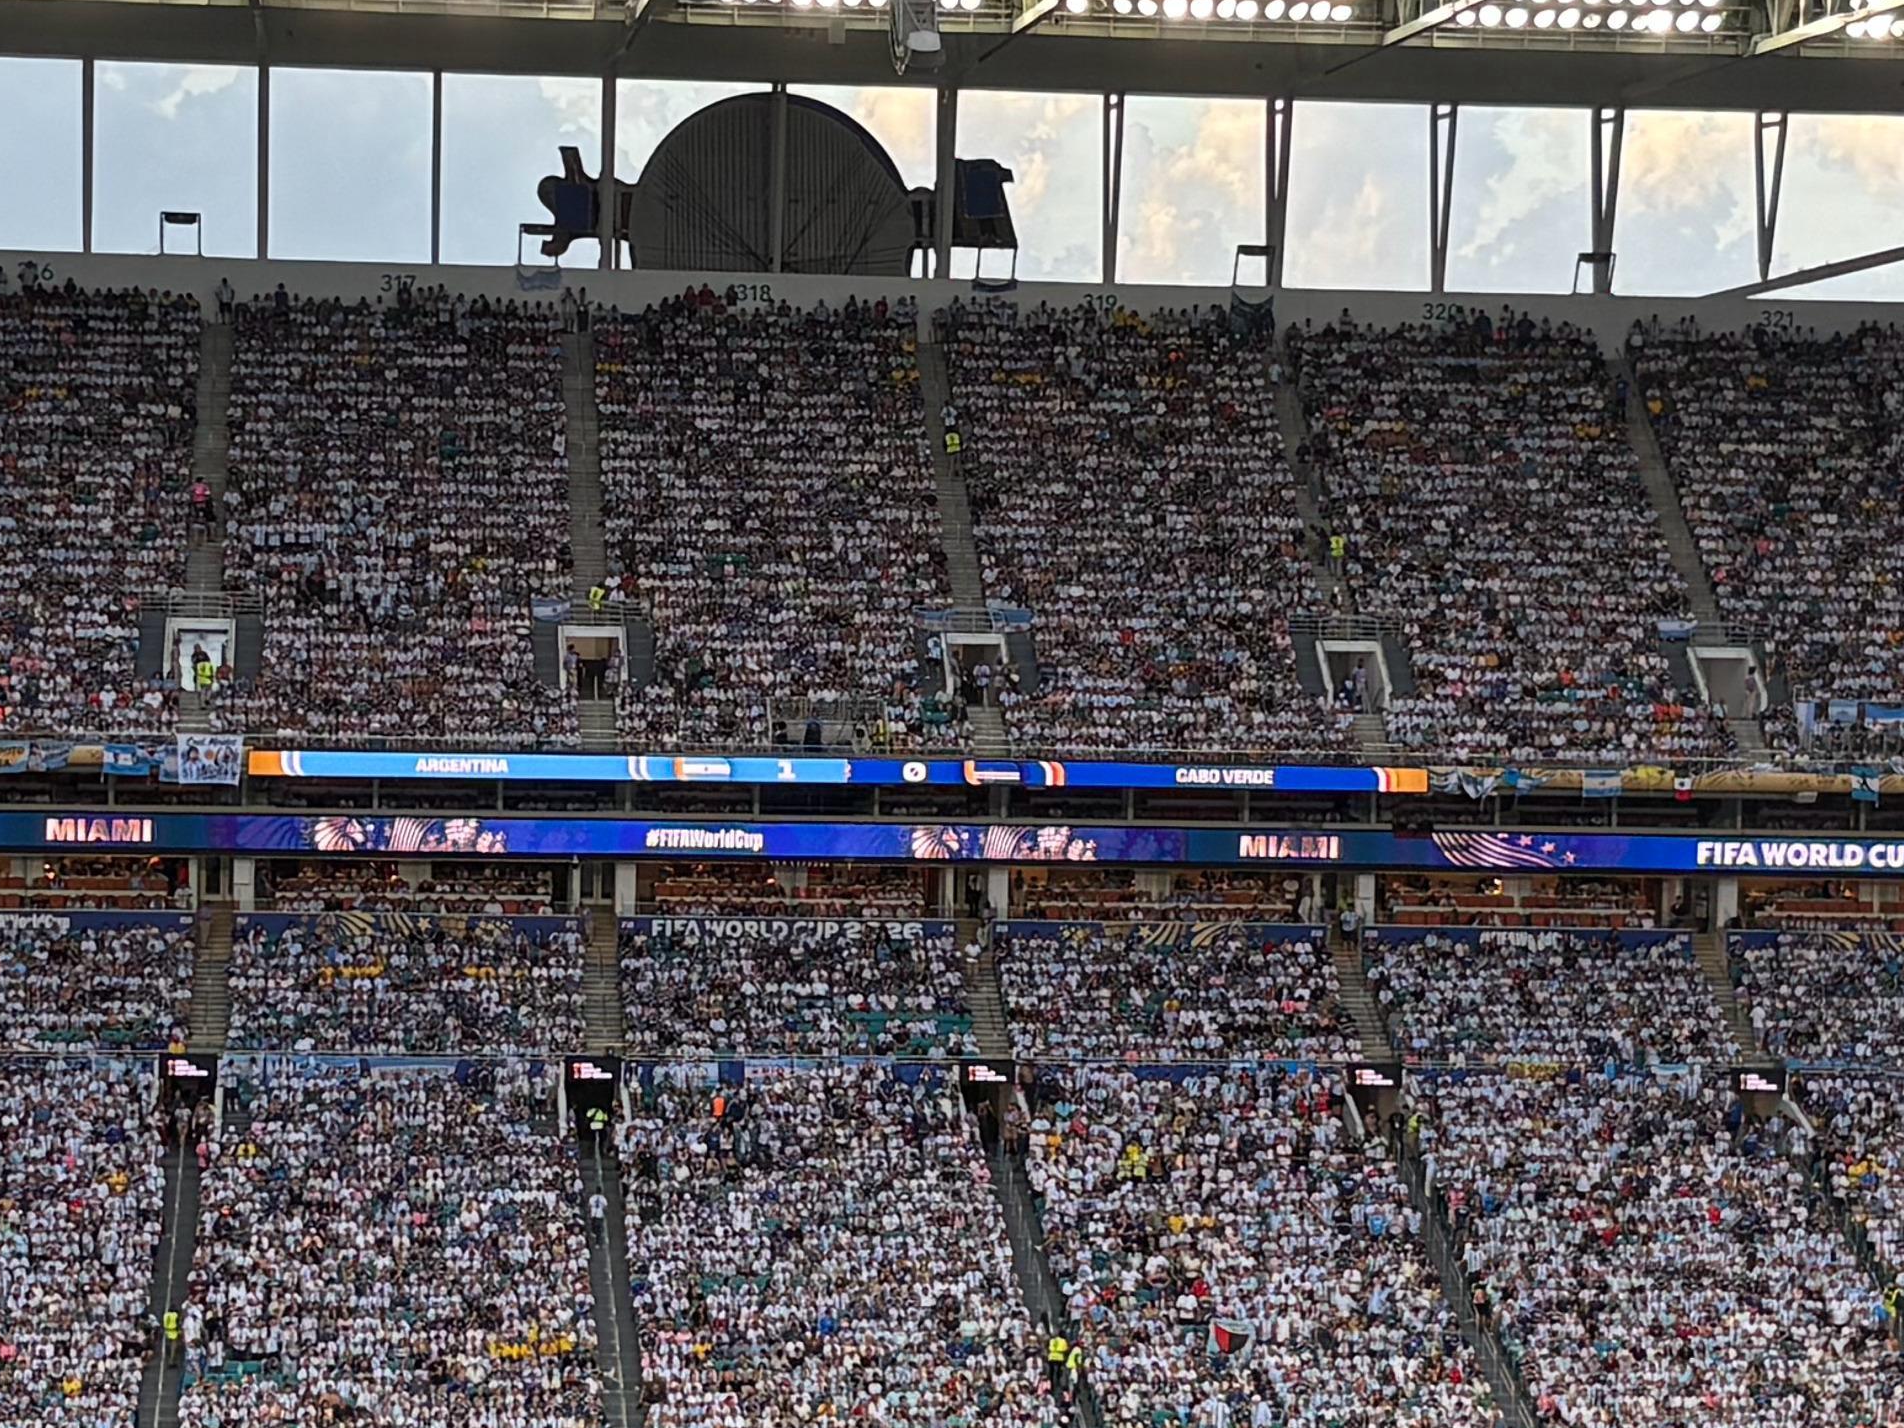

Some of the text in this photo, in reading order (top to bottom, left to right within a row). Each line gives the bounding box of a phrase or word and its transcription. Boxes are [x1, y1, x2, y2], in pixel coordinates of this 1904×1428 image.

[380, 274, 418, 293] 317
[736, 274, 772, 292] 318
[1760, 310, 1794, 327] 321
[414, 757, 509, 774] ARGENTINA
[777, 759, 797, 780] 1
[902, 761, 927, 784] 0
[1174, 767, 1274, 785] CABO VERDE
[44, 818, 154, 843] MIAMI
[645, 828, 765, 853] #FIFAWorldCup
[1238, 835, 1340, 860] MIAMI
[1696, 841, 1759, 867] FIFA
[1760, 842, 1866, 868] WORLD
[650, 918, 701, 939] FIFA
[704, 919, 789, 940] WORLD
